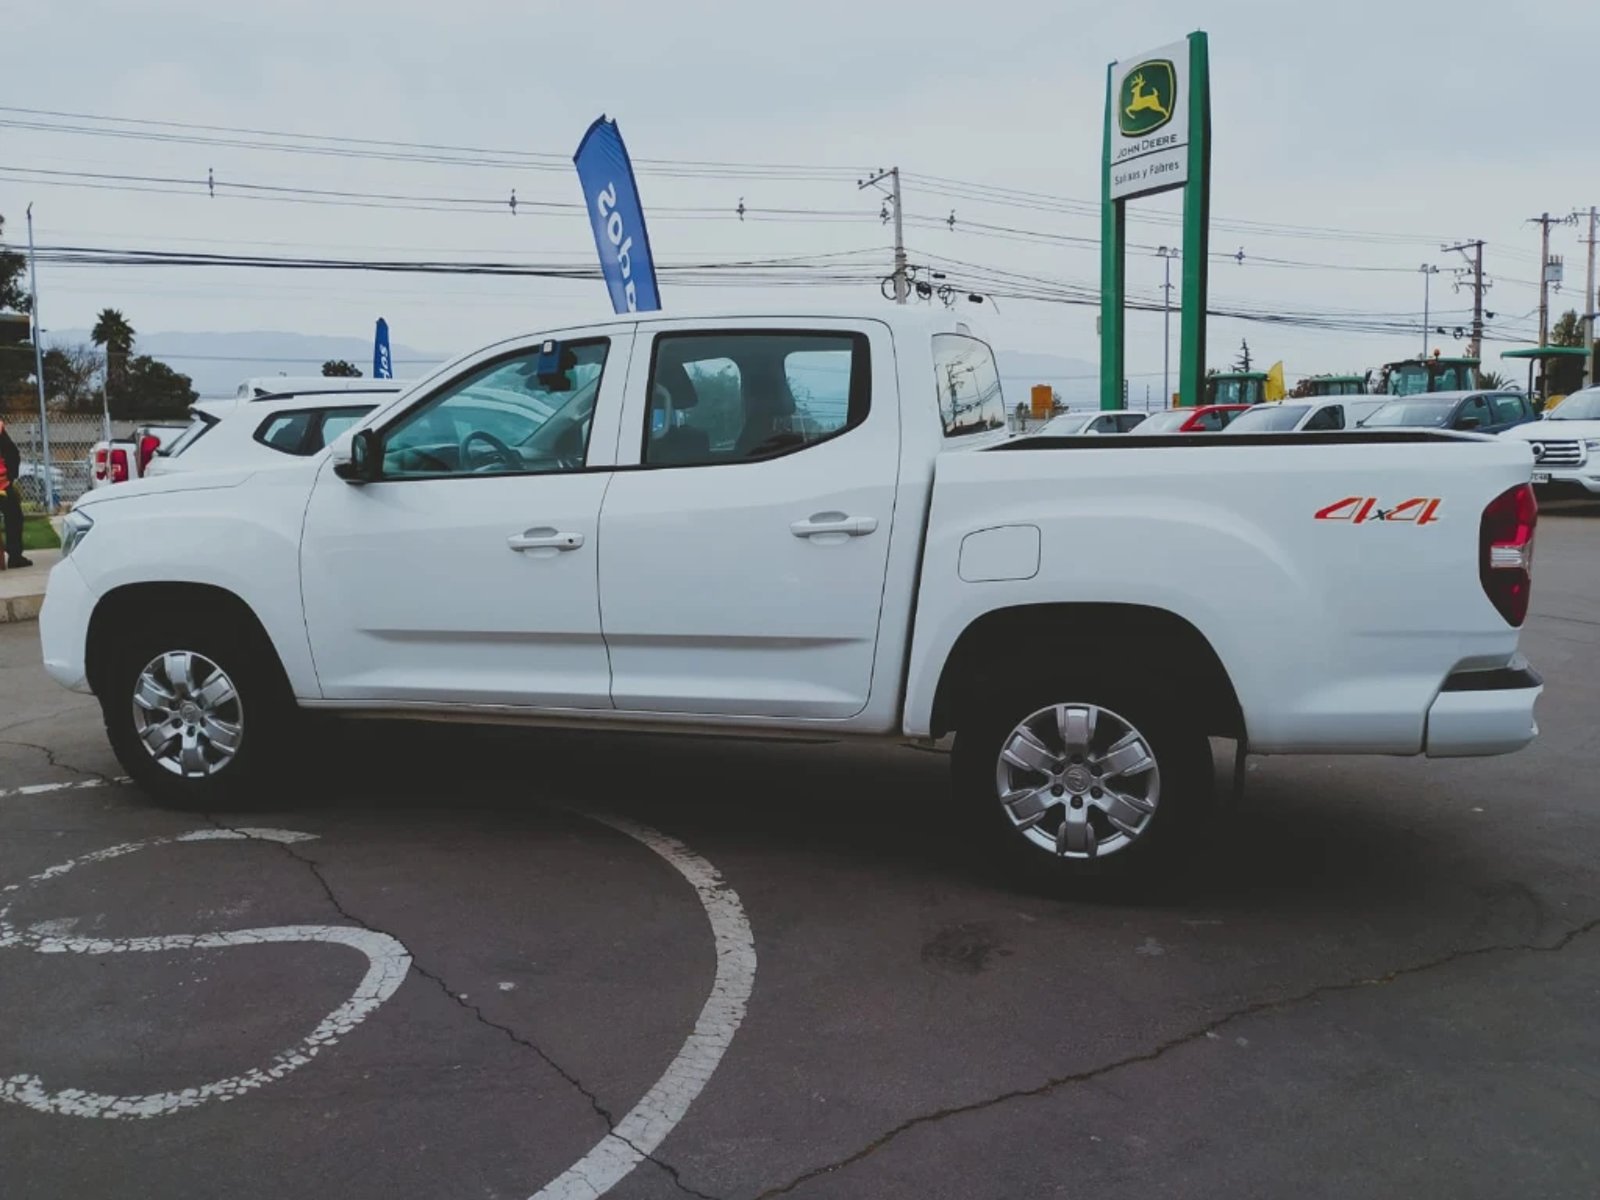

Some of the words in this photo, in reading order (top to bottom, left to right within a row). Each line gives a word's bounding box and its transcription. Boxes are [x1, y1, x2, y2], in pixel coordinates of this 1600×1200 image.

[1117, 143, 1140, 159] JOHN
[1141, 133, 1178, 151] DEERE
[1149, 161, 1180, 176] Fabres
[1313, 497, 1442, 525] 4x4
